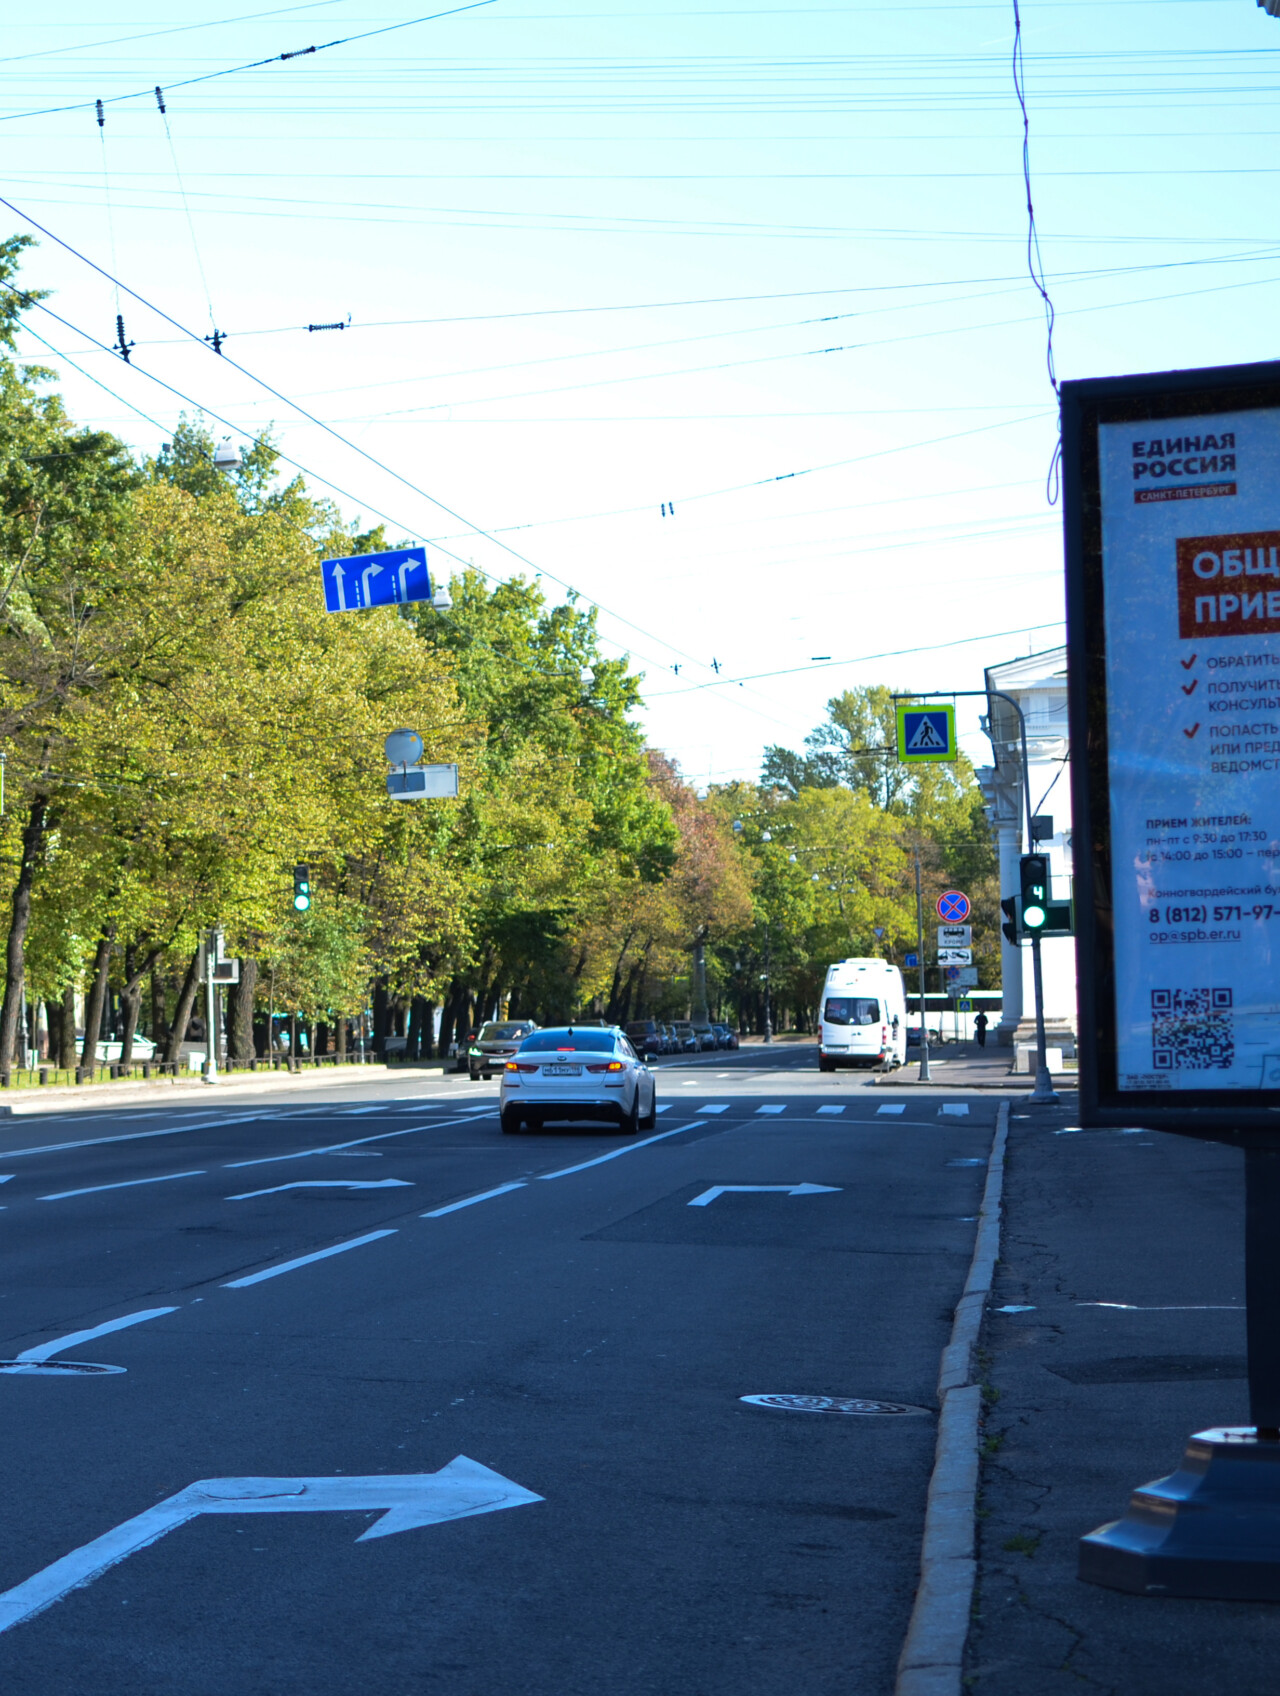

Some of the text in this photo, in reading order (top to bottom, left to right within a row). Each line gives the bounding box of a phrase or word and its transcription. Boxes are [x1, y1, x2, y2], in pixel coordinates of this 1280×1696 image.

[1132, 432, 1235, 458] ЕДИНАЯ
[1133, 453, 1236, 479] РОССИЯ
[1140, 485, 1231, 502] САНКТ-ПЕТЕРБУРГ
[1210, 722, 1279, 737] ПОПАСТЬ
[1210, 743, 1241, 755] ИЛИ
[1146, 813, 1252, 830] ПРИЕМ ЖИТЕЛЕЙ:
[1146, 836, 1180, 846] пн-пт
[1192, 833, 1217, 844] 9:30
[1220, 833, 1236, 844] до
[1238, 831, 1268, 842] 17:30
[1160, 850, 1191, 861] 14:00
[1193, 851, 1209, 862] до
[1212, 848, 1243, 860] 15:00
[1033, 885, 1043, 900] 4
[1148, 885, 1262, 898] Конногвардейский
[1149, 908, 1160, 923] 8
[1166, 905, 1207, 925] (812)
[1149, 928, 1241, 944] op@spb.er.ru
